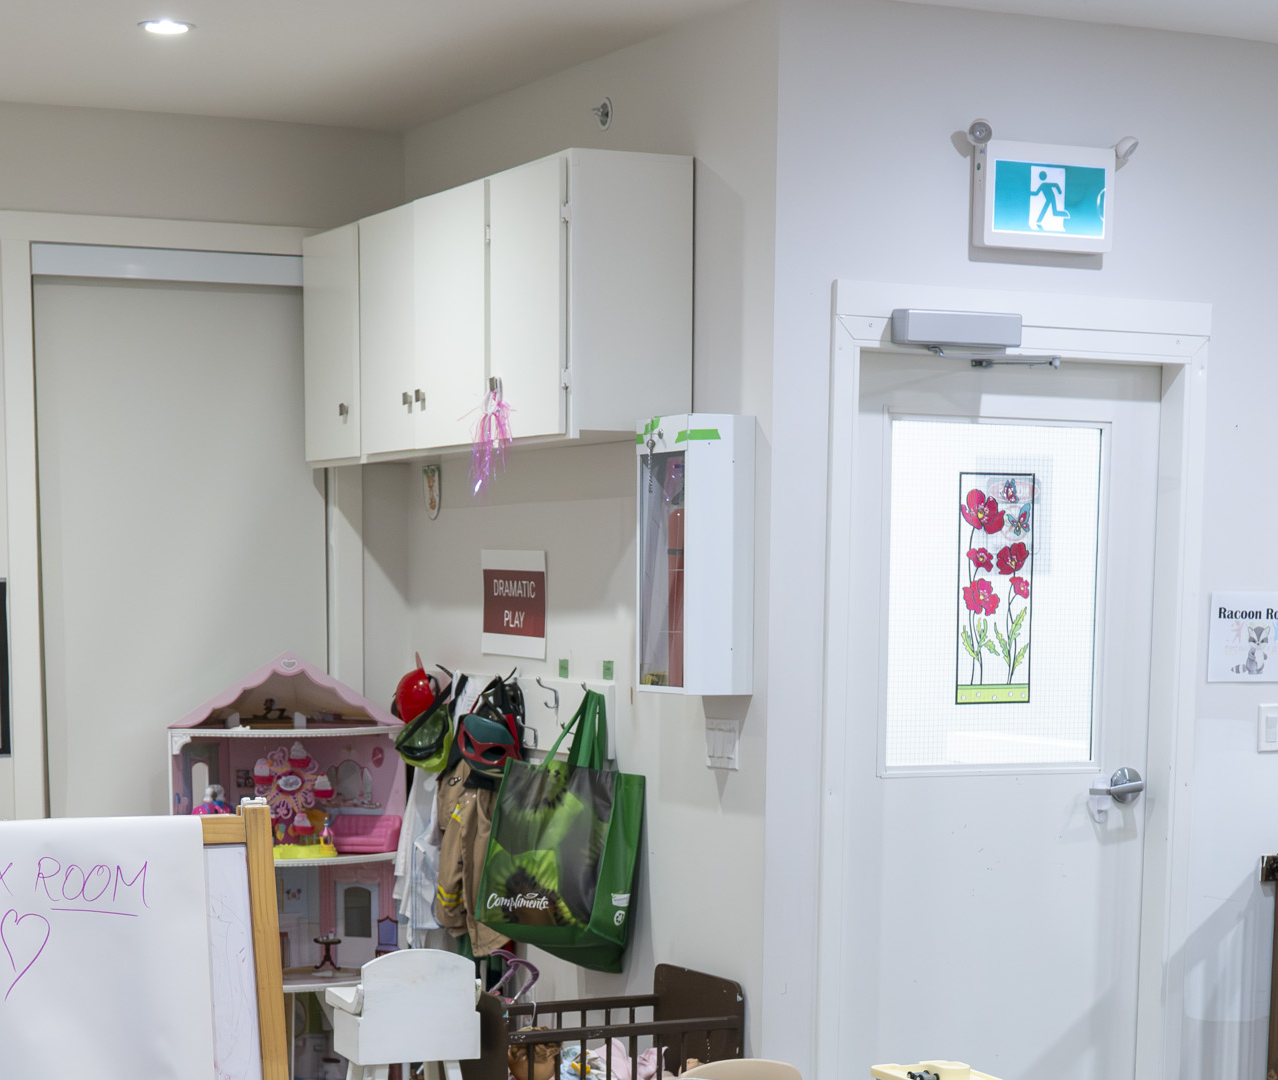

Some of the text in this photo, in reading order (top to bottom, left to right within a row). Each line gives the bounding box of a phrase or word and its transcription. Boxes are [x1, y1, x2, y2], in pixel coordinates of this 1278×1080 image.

[493, 579, 536, 598] DRAMATIC
[503, 610, 525, 628] PLAY
[1218, 607, 1262, 619] Racoon
[35, 856, 150, 908] ROOM
[486, 892, 549, 912] Compliments
